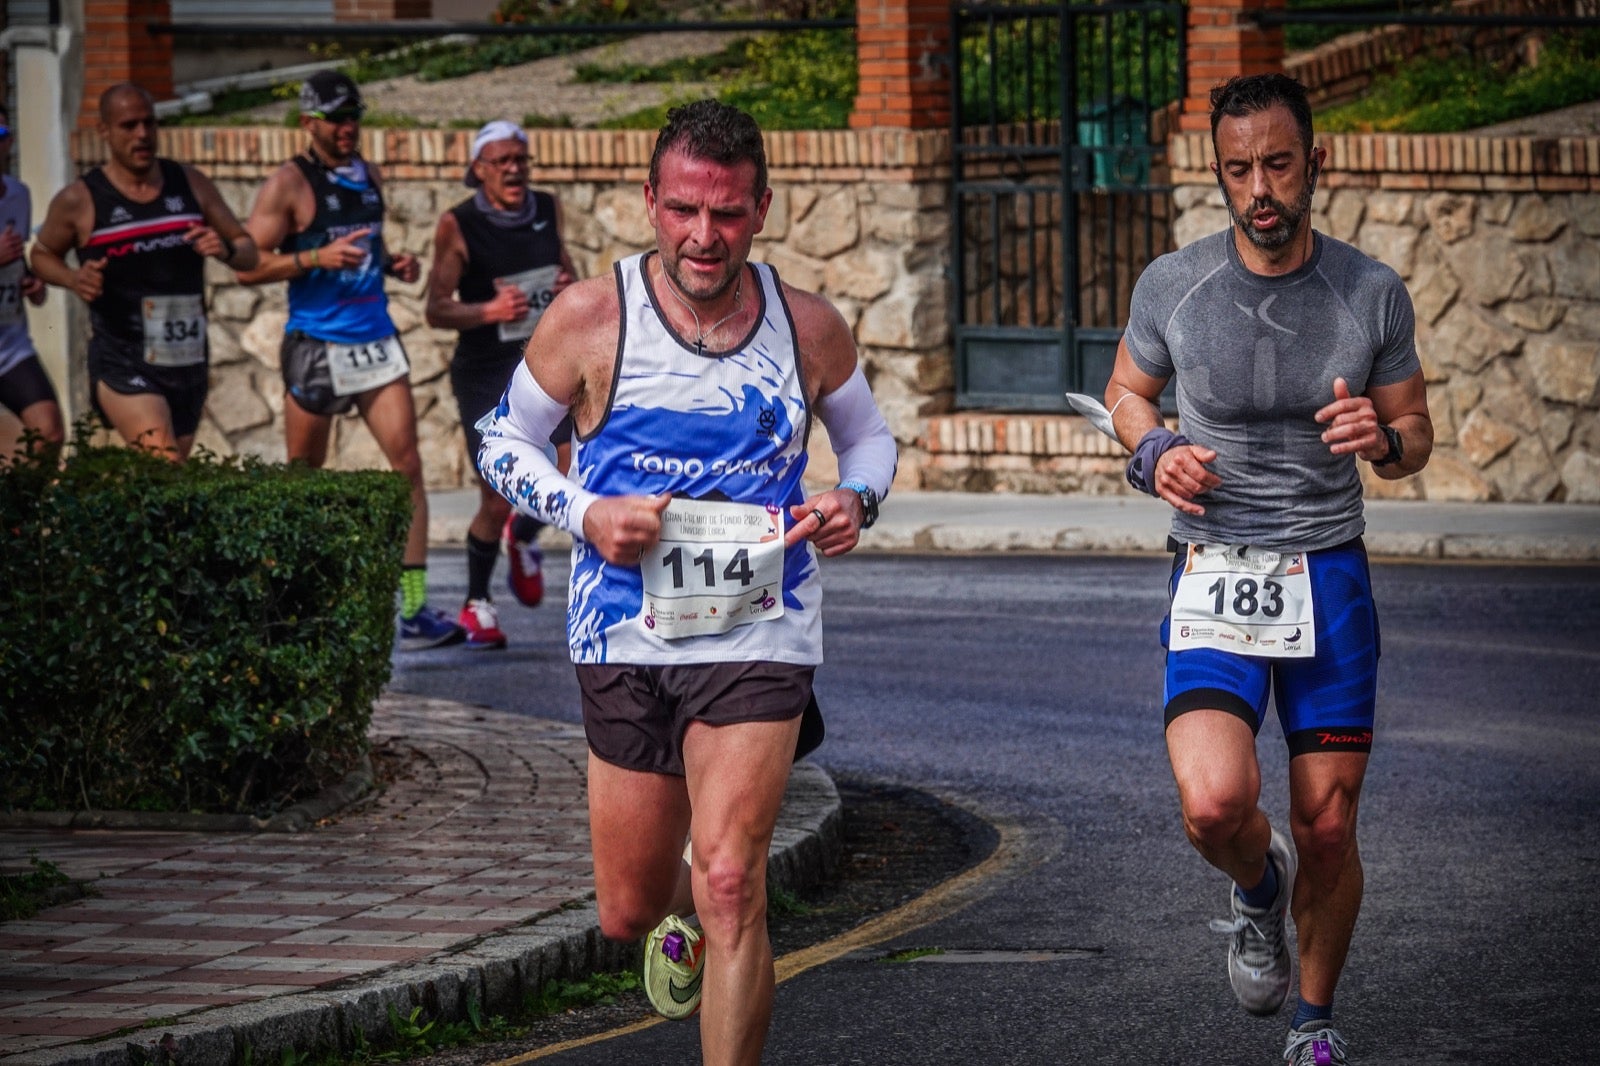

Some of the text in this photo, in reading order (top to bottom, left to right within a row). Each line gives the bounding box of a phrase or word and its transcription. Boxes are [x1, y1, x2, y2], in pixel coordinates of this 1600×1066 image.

[164, 319, 199, 342] 334
[348, 342, 388, 367] 113
[631, 453, 774, 479] TODO SUMA
[664, 511, 762, 526] GRAN PREMIO DE FONDO 2022
[663, 547, 754, 589] 114
[1208, 576, 1285, 618] 183
